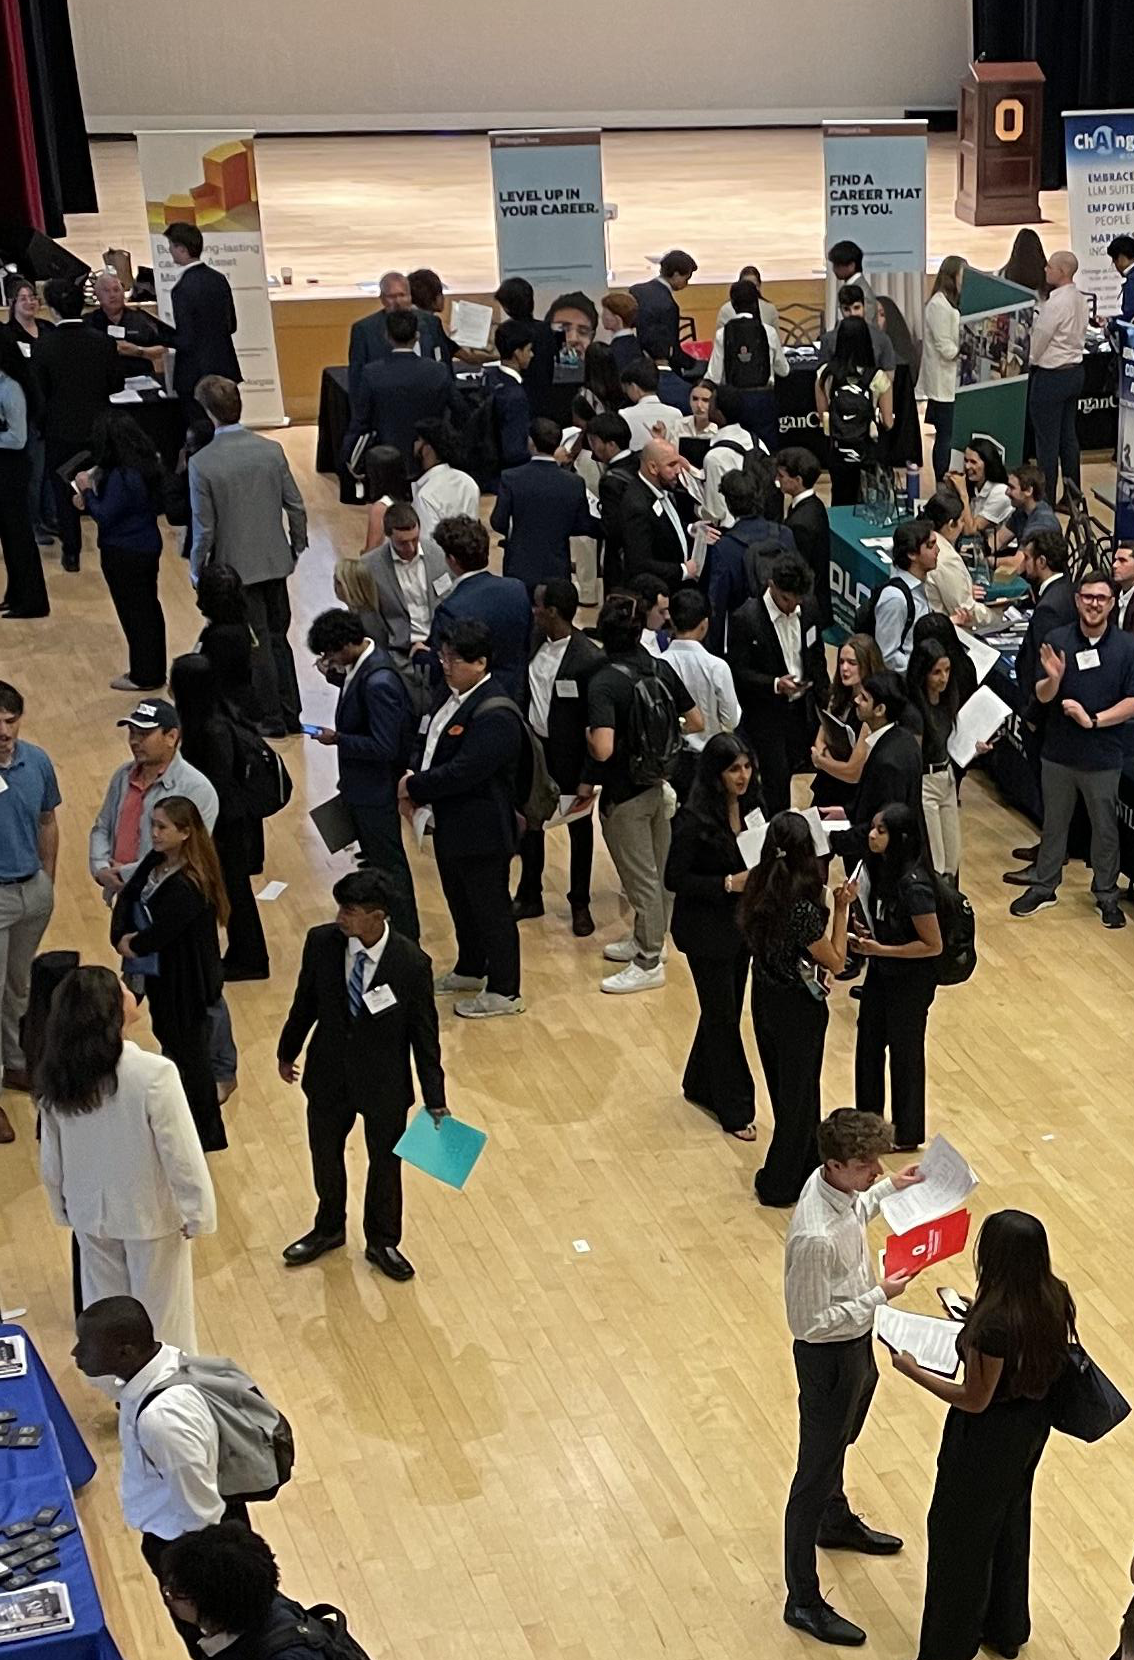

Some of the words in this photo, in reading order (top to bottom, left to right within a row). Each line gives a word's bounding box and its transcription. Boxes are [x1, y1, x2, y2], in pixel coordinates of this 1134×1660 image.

[829, 174, 861, 187] FIND
[863, 174, 874, 185] A
[1088, 171, 1134, 183] EMBRACE
[499, 190, 542, 203] LEVEL
[544, 189, 563, 201] UP
[566, 188, 580, 200] IN
[829, 188, 883, 201] CAREER
[886, 188, 922, 200] THAT
[1088, 185, 1107, 196] LLM
[1109, 183, 1134, 195] SUITE
[500, 204, 538, 218] YOUR
[541, 203, 599, 215] CAREER.
[829, 204, 859, 217] FITS
[862, 203, 893, 216] YOU.
[1095, 215, 1131, 226] PEOPLE
[206, 243, 260, 255] ng-lasting
